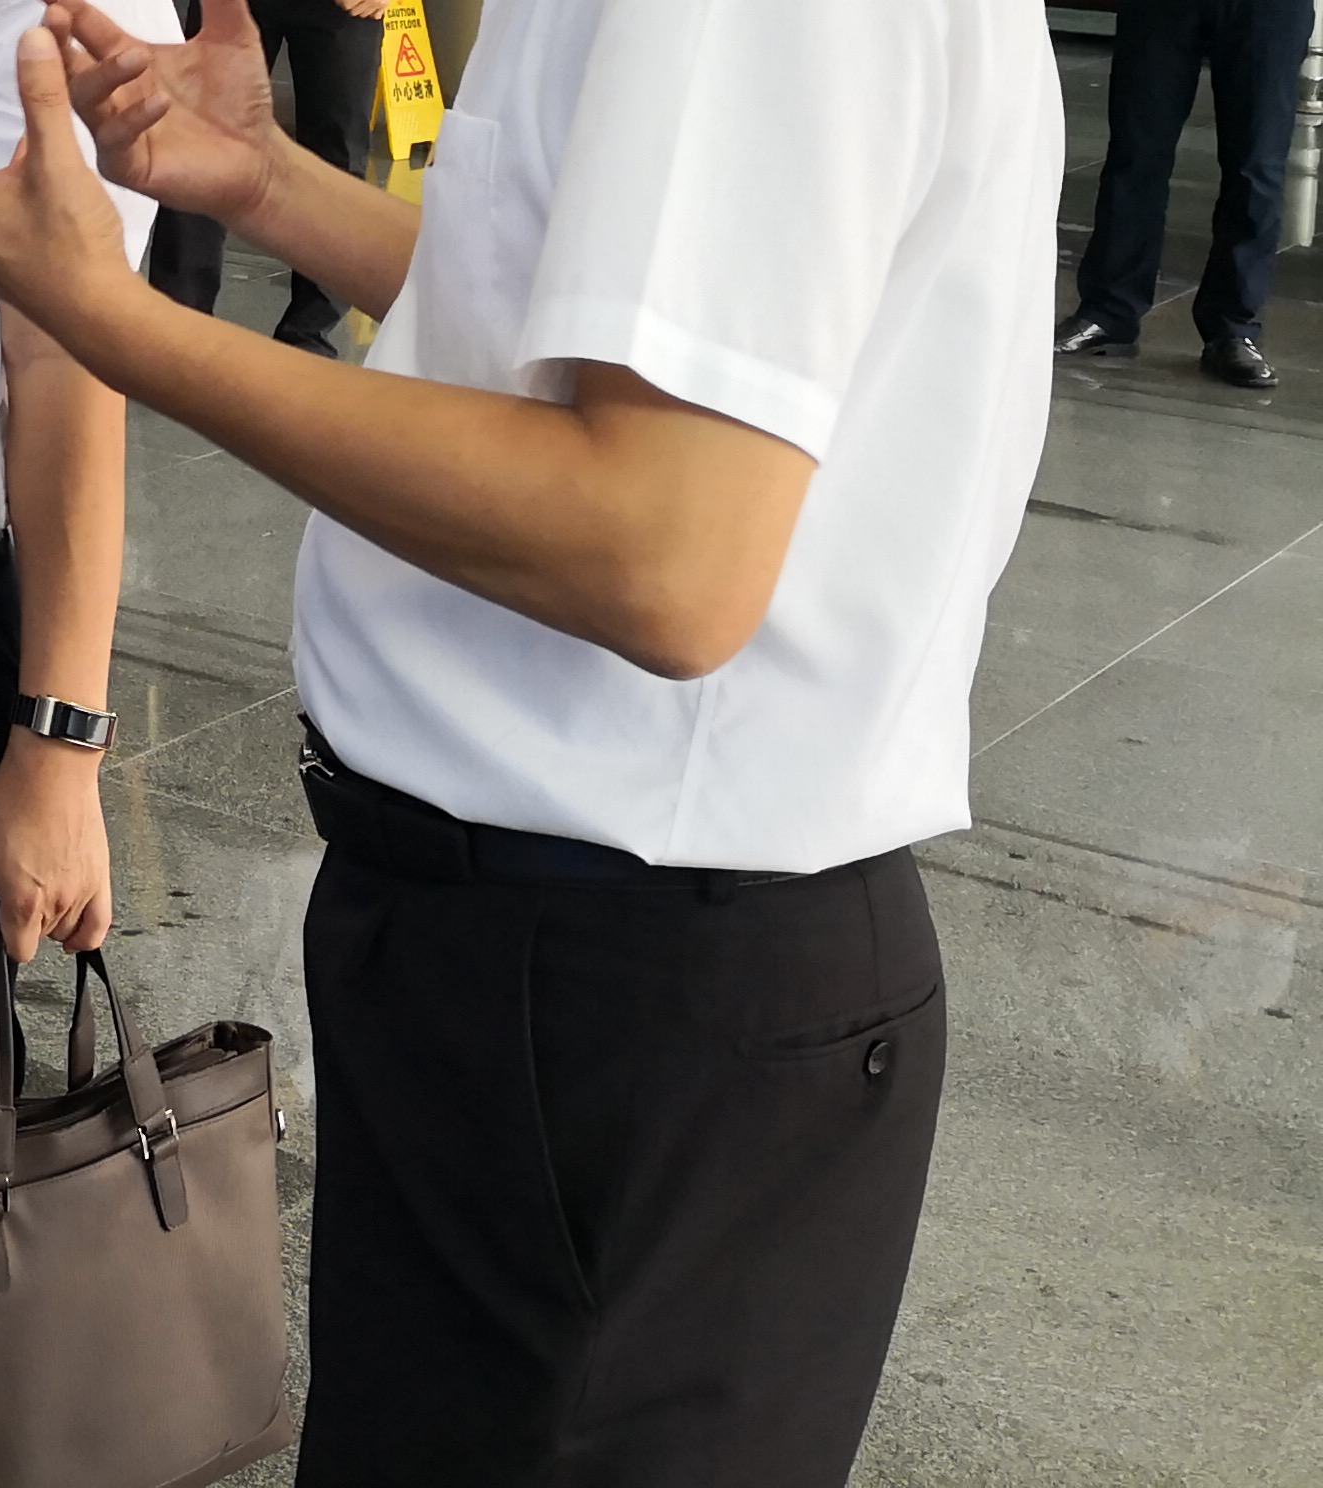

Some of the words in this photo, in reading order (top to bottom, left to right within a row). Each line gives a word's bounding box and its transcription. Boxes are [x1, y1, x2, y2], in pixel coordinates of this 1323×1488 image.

[386, 7, 417, 19] CAUTION
[385, 21, 399, 31] WET
[399, 19, 422, 31] FLOOR
[392, 79, 435, 103] 小心地滑
